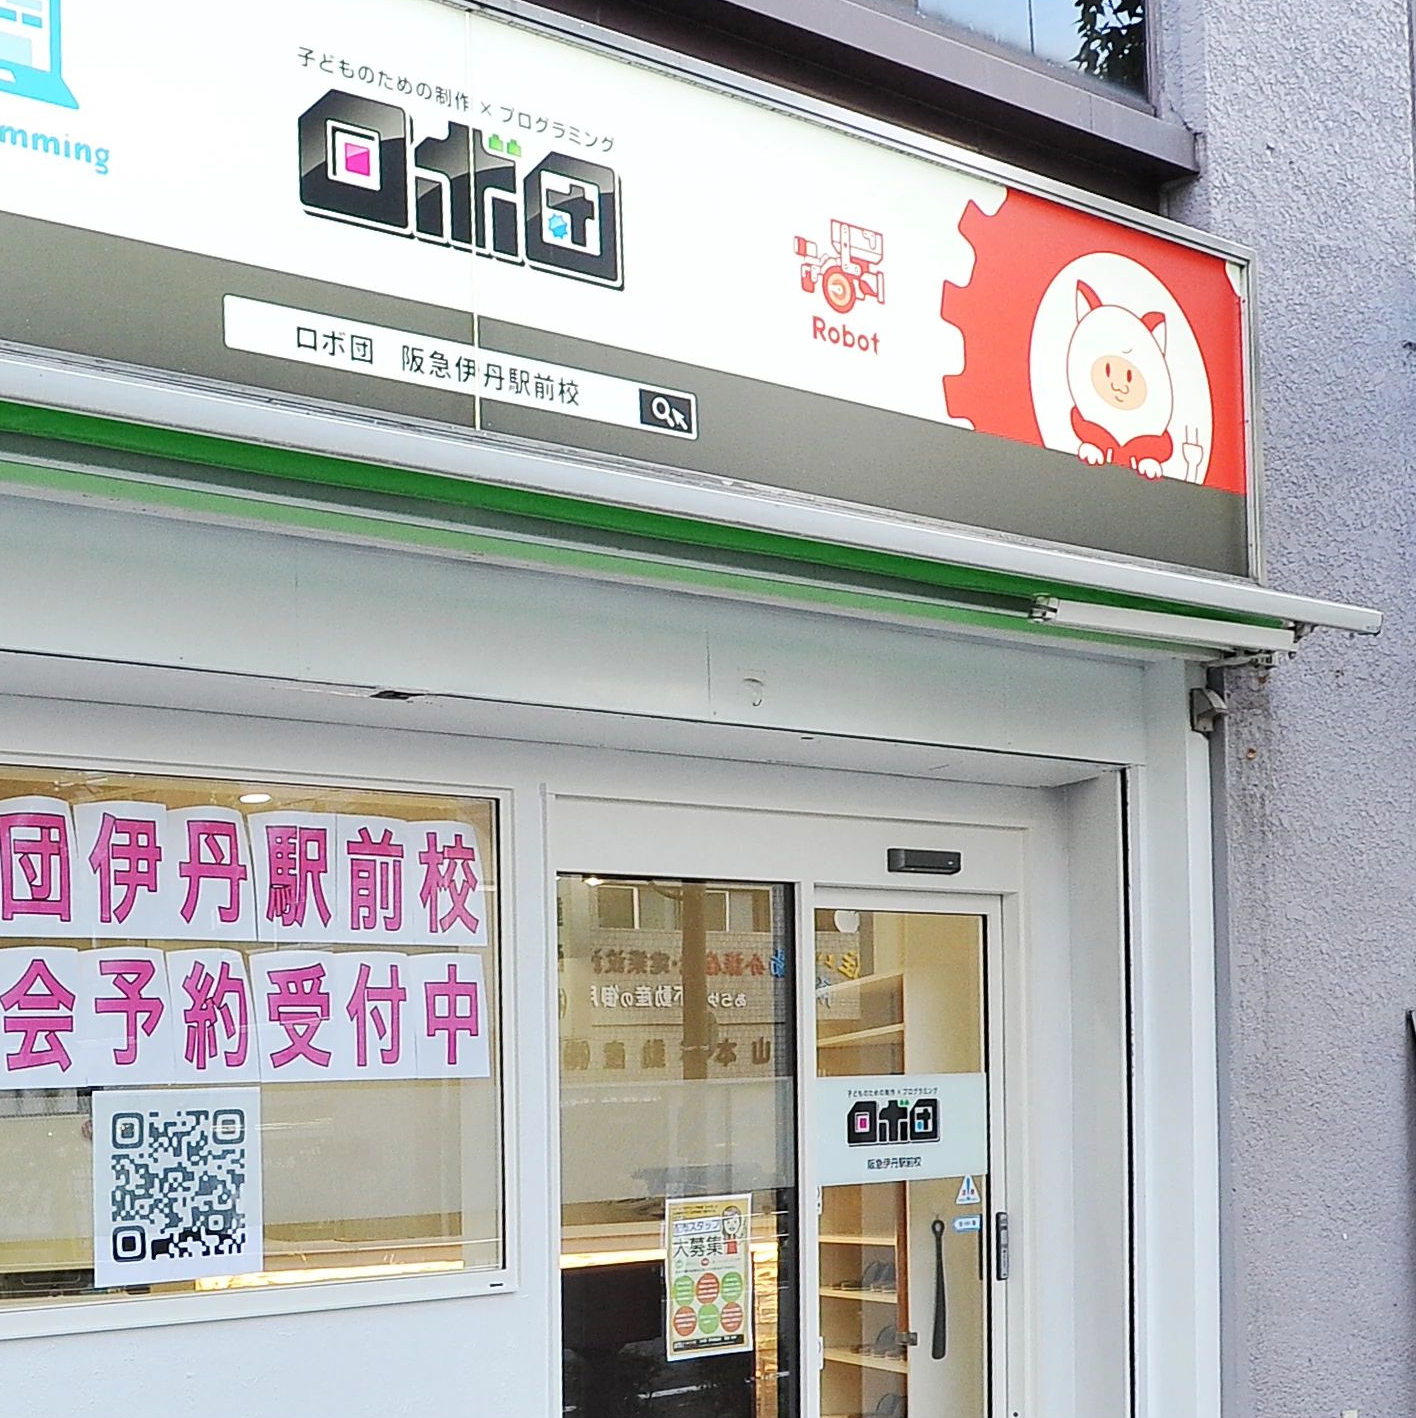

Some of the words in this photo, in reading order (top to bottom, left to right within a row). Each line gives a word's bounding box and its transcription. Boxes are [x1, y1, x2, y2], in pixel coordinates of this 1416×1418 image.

[298, 89, 625, 292] ロボ団
[812, 316, 880, 355] Robot
[296, 326, 374, 365] ロボ団
[401, 345, 580, 407] 阪急伊丹駅前校
[846, 1098, 941, 1147] ロボ団
[672, 1236, 723, 1258] 大募集
